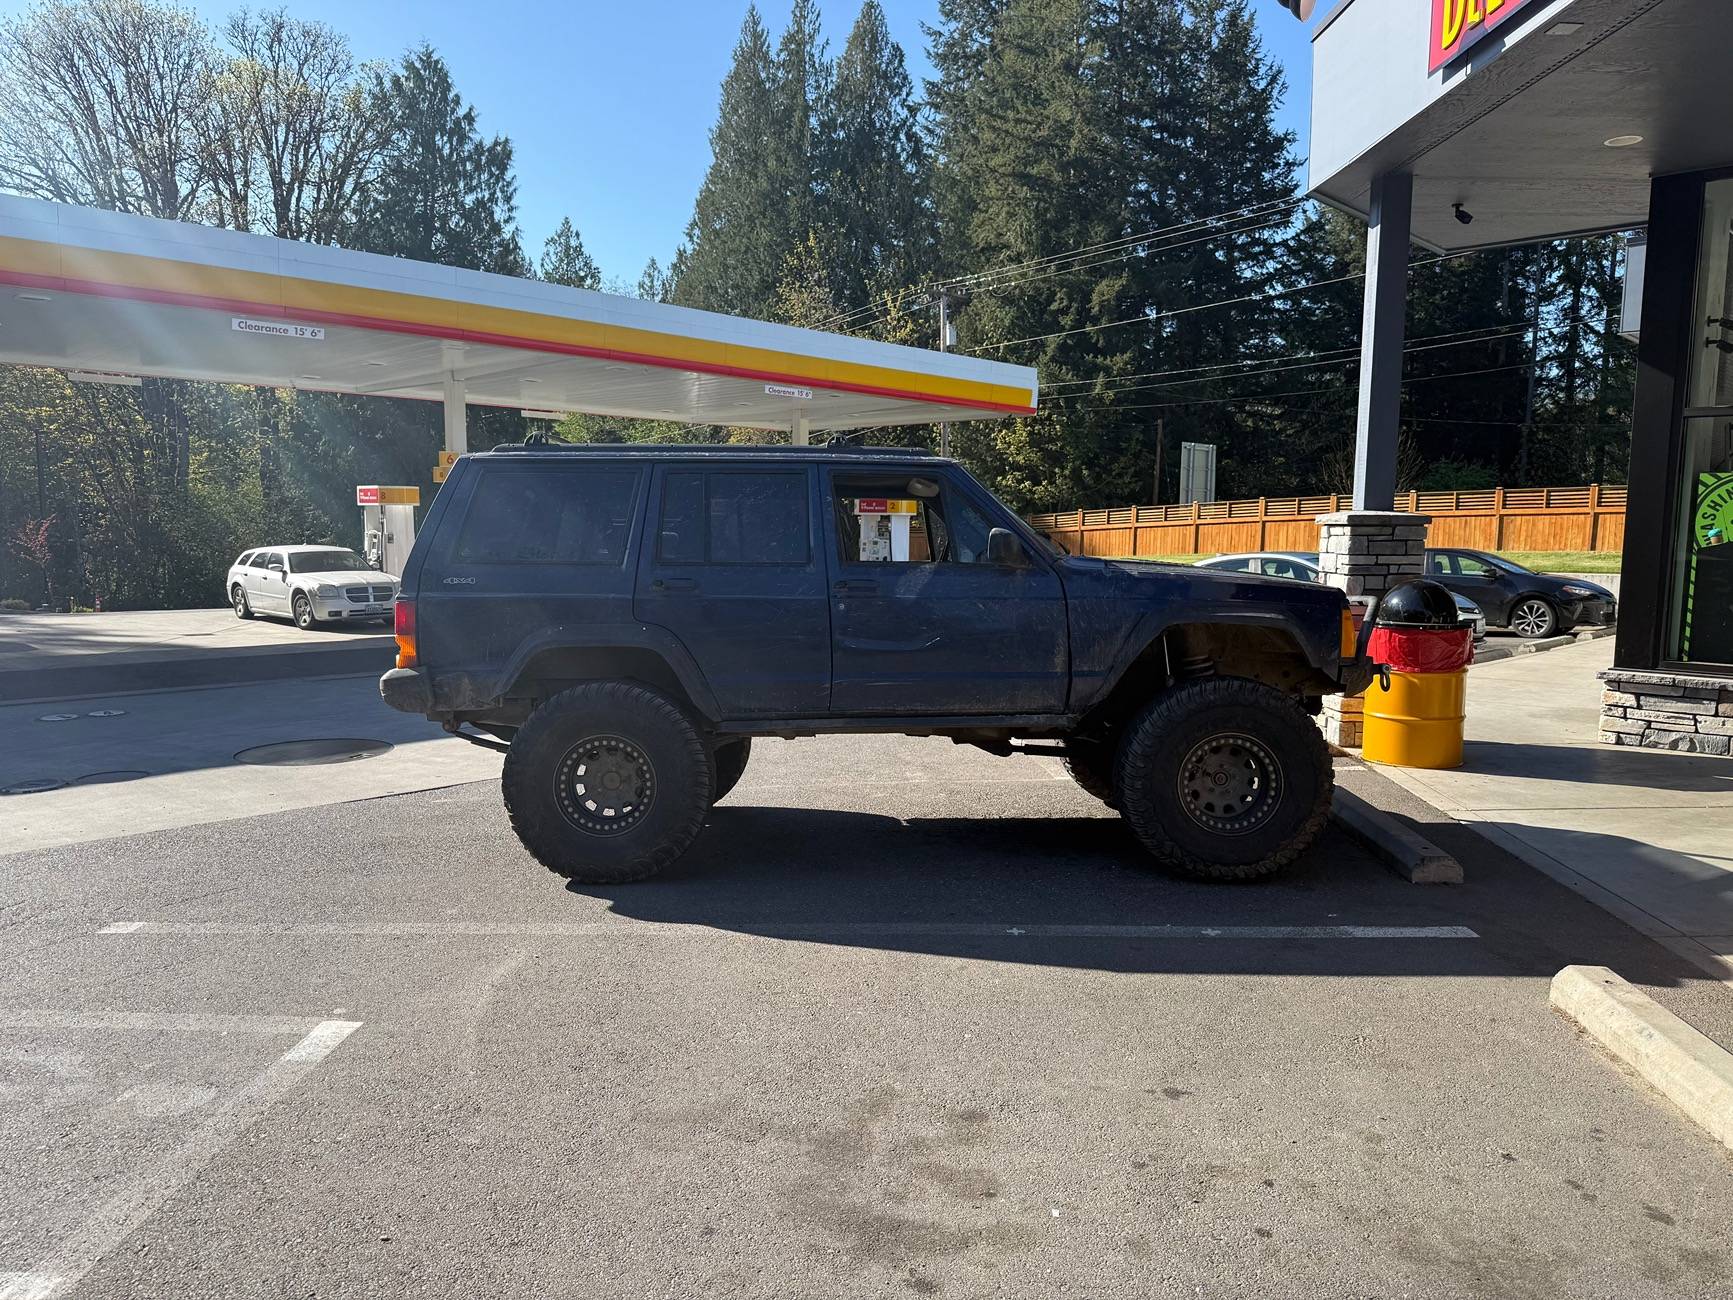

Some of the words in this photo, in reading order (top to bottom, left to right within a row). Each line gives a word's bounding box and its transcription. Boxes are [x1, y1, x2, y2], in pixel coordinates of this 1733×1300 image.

[238, 321, 289, 334] Clearance
[294, 327, 308, 336] 15'
[310, 329, 321, 337] 6"
[768, 387, 795, 395] Clearance
[447, 454, 454, 464] 6
[889, 502, 896, 510] 2
